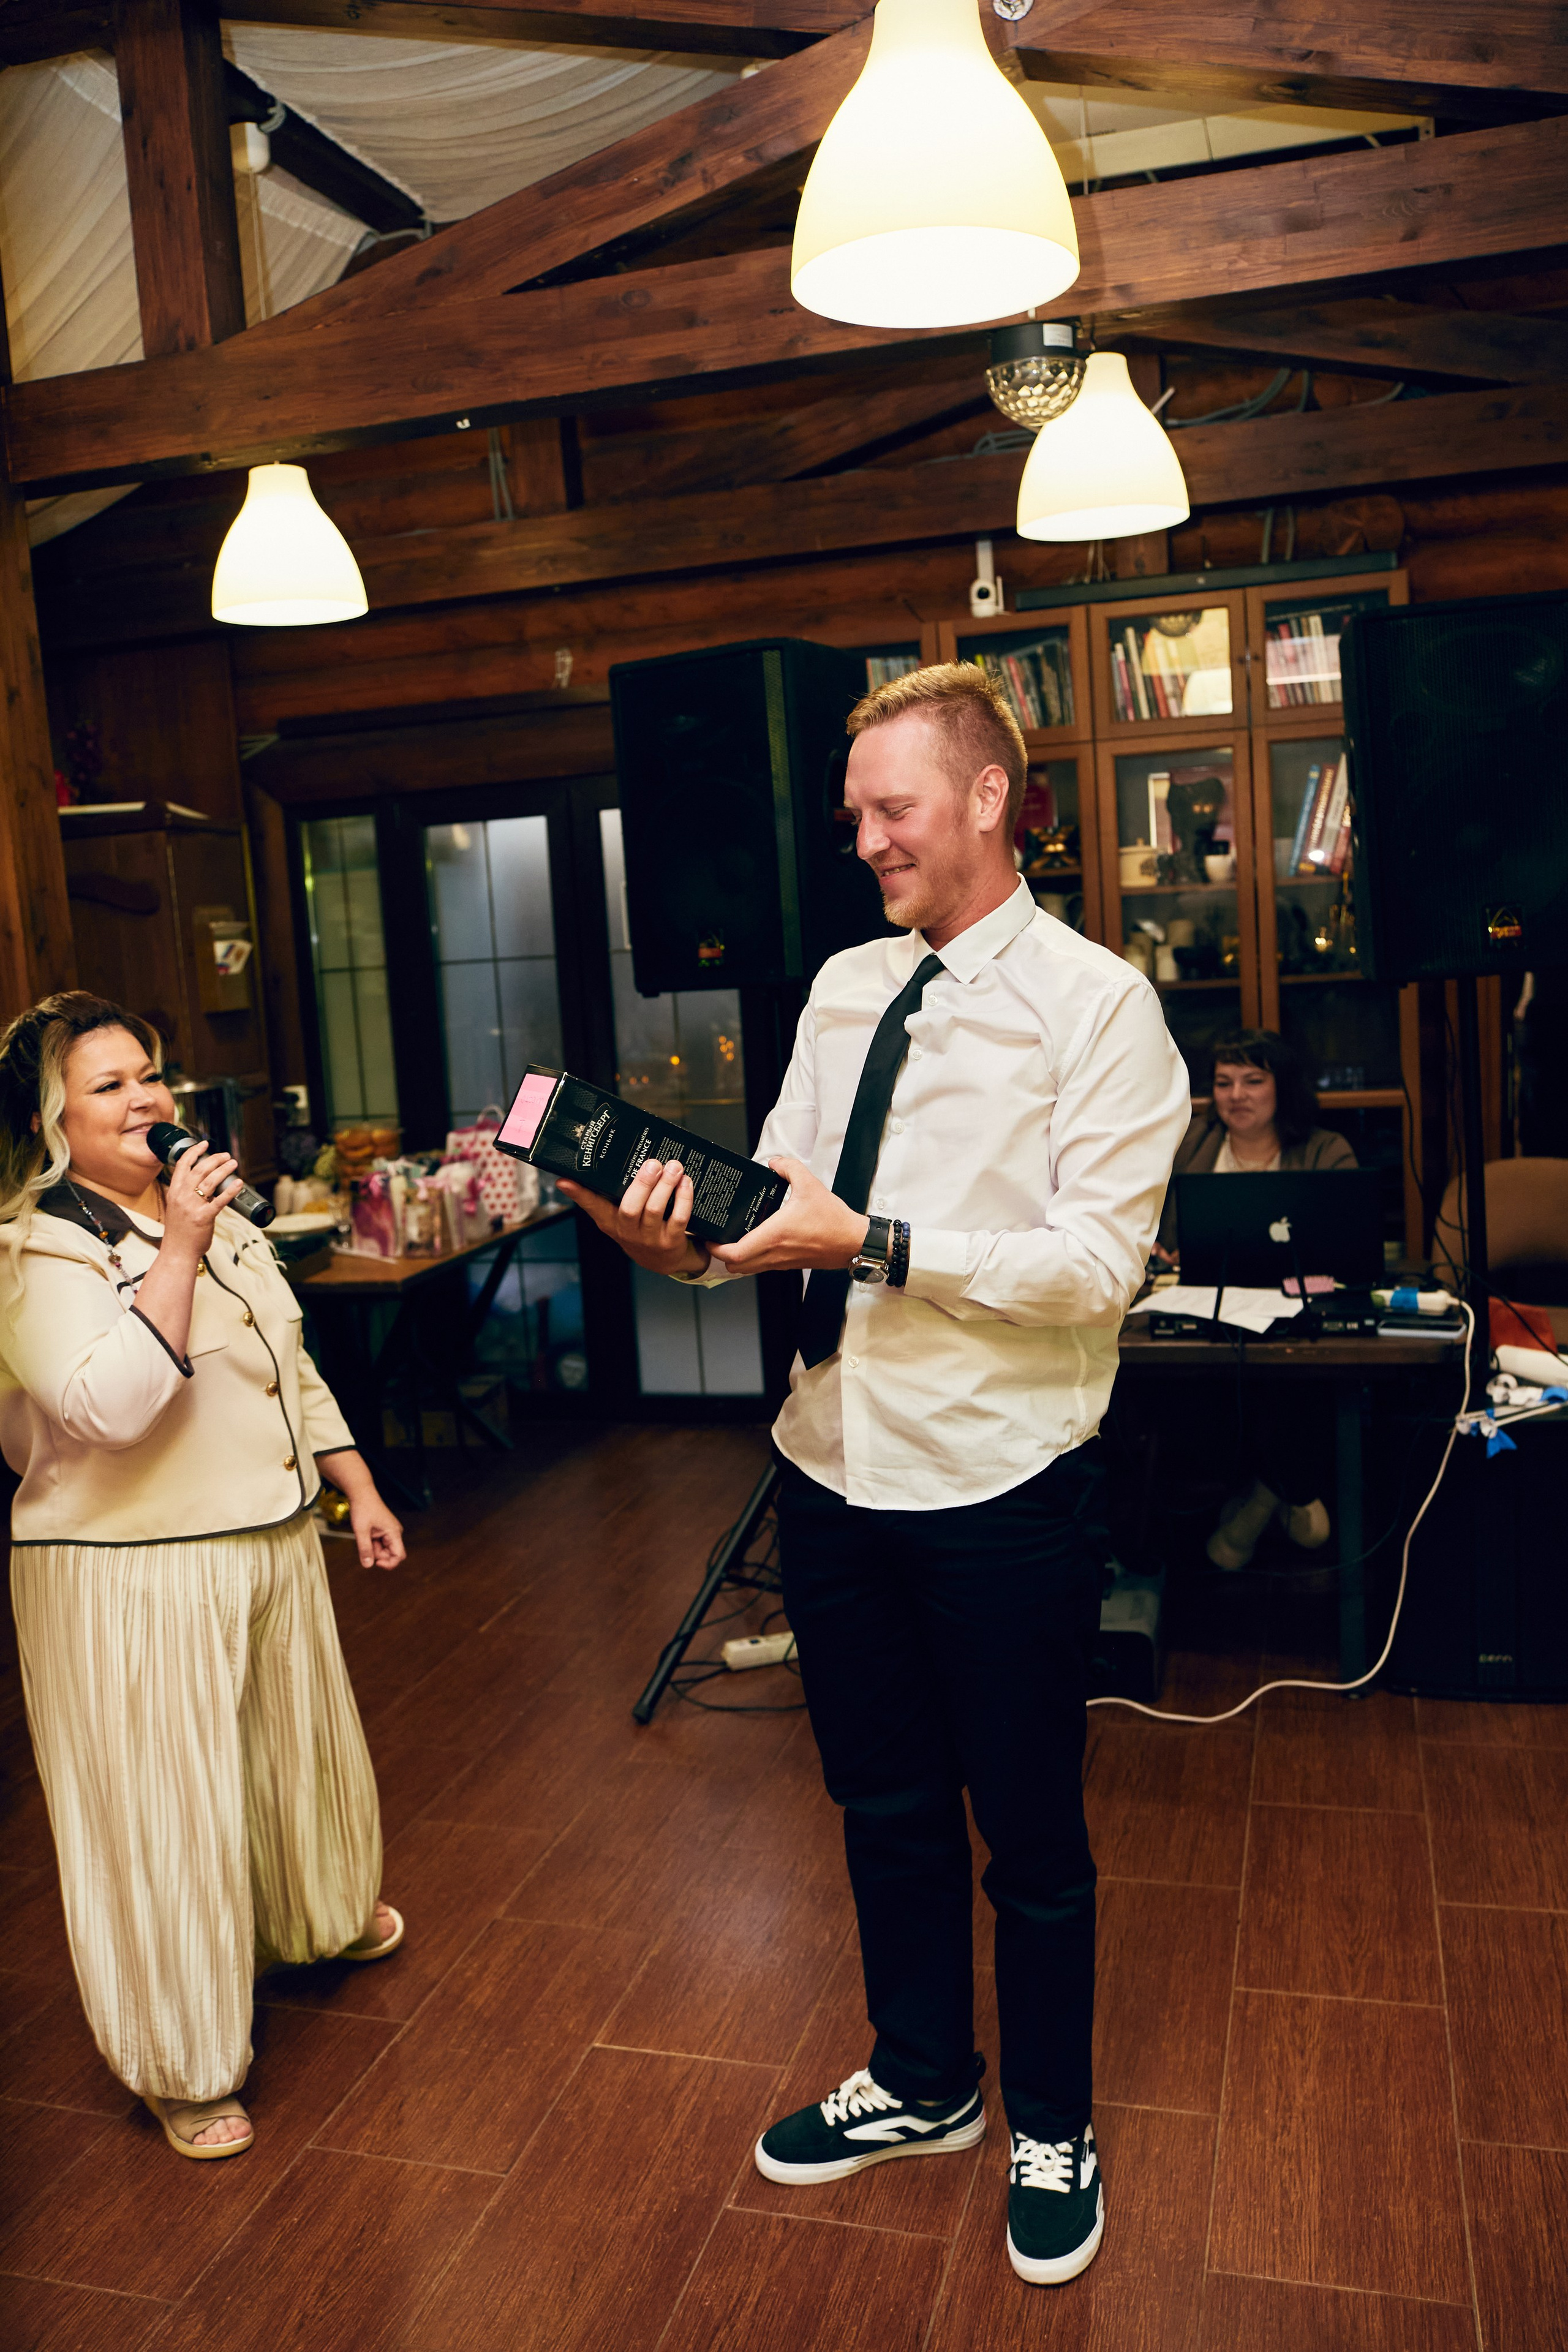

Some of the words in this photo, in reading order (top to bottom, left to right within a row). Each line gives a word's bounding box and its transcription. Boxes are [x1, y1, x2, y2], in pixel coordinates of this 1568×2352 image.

[580, 1120, 595, 1149] СТАРЫЙ
[583, 1110, 610, 1166] КЕНИГСБЕРГ
[600, 1129, 616, 1158] КОНЬЯК
[627, 1151, 638, 1173] MATIÈRES
[636, 1126, 649, 1151] PREMIÈRES
[630, 1167, 639, 1178] DE
[635, 1139, 651, 1167] FRANCE
[752, 1185, 766, 1212] Tessendier
